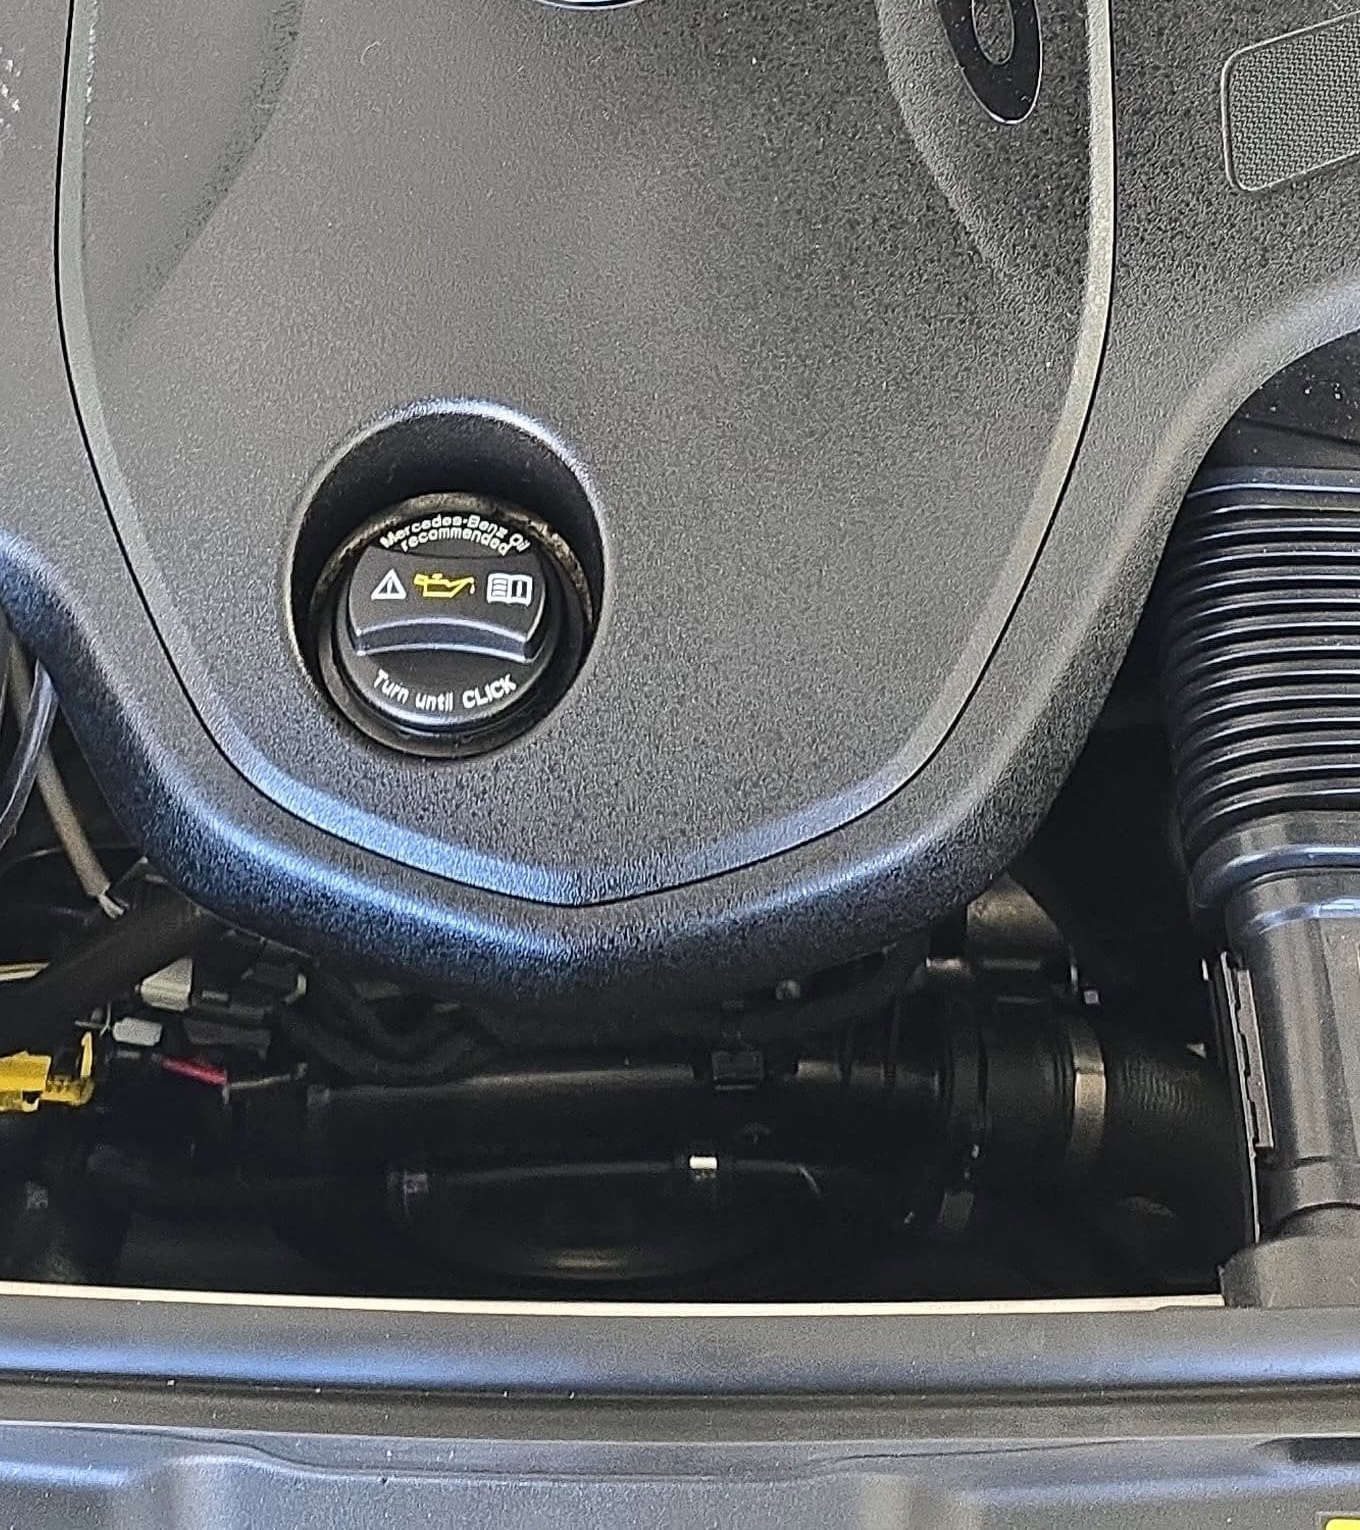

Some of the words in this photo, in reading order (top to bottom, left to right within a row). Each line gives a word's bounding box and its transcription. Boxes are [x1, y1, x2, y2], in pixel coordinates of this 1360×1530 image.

[379, 514, 508, 549] Mercedes-Benz
[509, 533, 530, 553] Oil
[401, 527, 511, 556] recommended
[373, 668, 409, 705] Turn
[415, 690, 454, 712] until
[462, 673, 517, 709] CLICK
